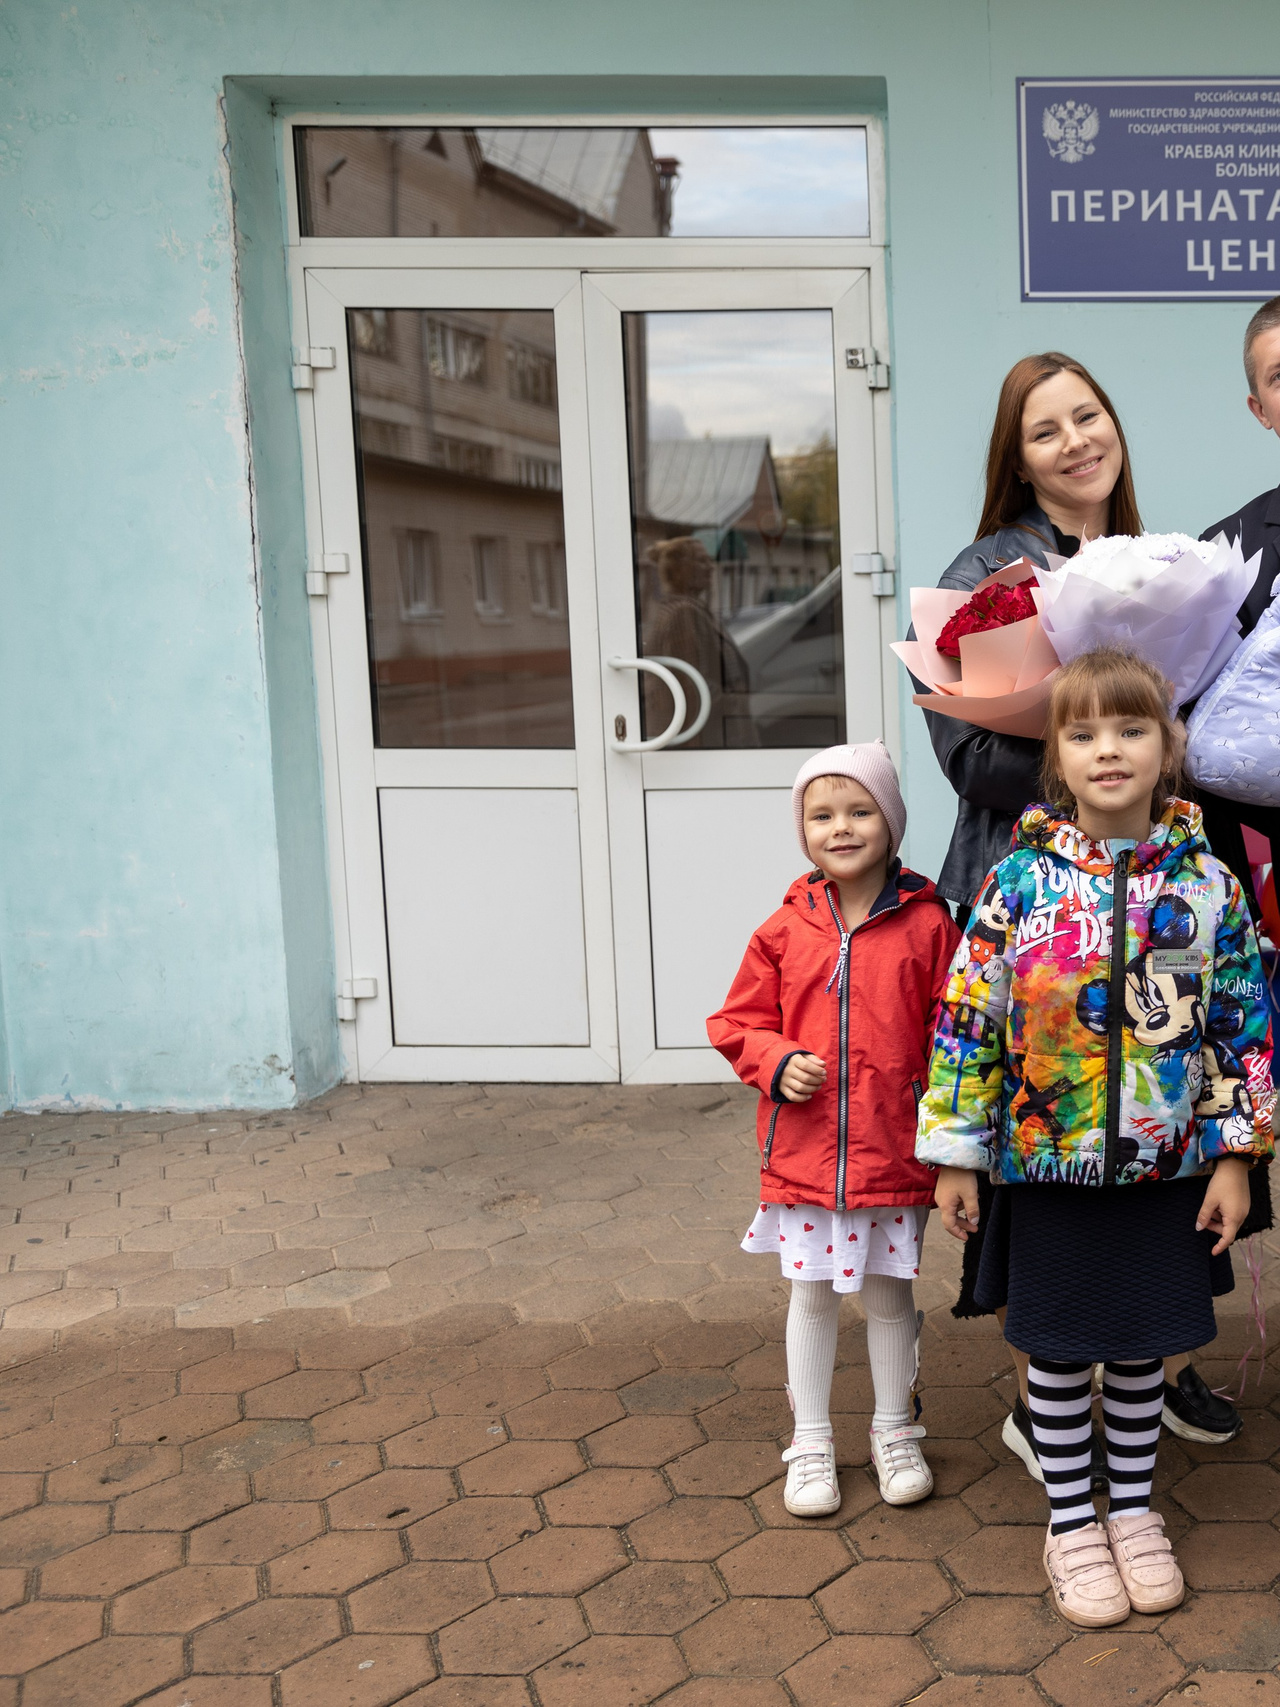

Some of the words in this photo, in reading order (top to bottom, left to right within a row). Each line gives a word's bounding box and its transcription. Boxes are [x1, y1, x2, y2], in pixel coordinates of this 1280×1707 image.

[1195, 90, 1258, 102] РОССИЙСКАЯ
[1109, 107, 1187, 118] МИНИСТЕРСТВО
[1128, 123, 1220, 135] ГОСУДАРСТВЕННОЕ
[1164, 144, 1235, 159] КРАЕВАЯ
[1165, 879, 1215, 908] MONEY
[1016, 903, 1064, 949] NOT
[1214, 976, 1263, 1001] MONEY
[1020, 1154, 1101, 1186] WANNA
